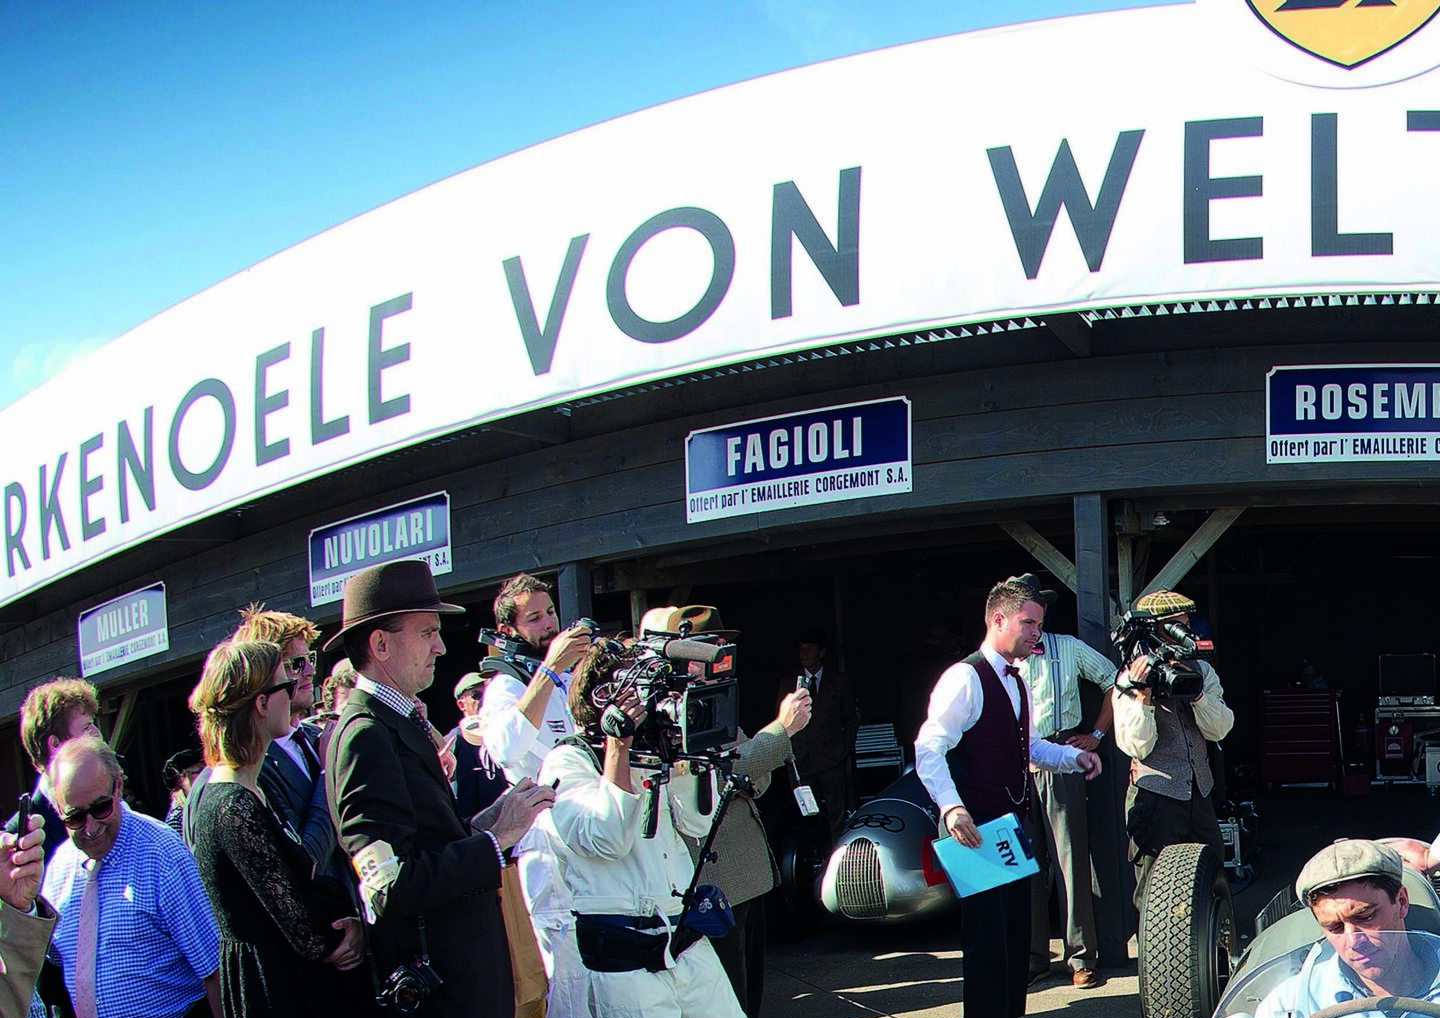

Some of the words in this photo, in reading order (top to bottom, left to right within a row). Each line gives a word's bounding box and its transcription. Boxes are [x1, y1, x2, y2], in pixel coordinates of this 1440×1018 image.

[502, 166, 862, 376] VON
[727, 416, 862, 476] FAGIOLI
[1271, 439, 1309, 457] Offert
[1313, 440, 1337, 457] par
[1352, 438, 1427, 455] EMAILLERIE
[690, 494, 719, 513] Offert
[721, 492, 740, 510] par
[815, 470, 880, 493] CORGEMONT
[887, 467, 908, 484] S.A.
[324, 508, 433, 569] NUVOLARI
[97, 599, 149, 642] MULLER
